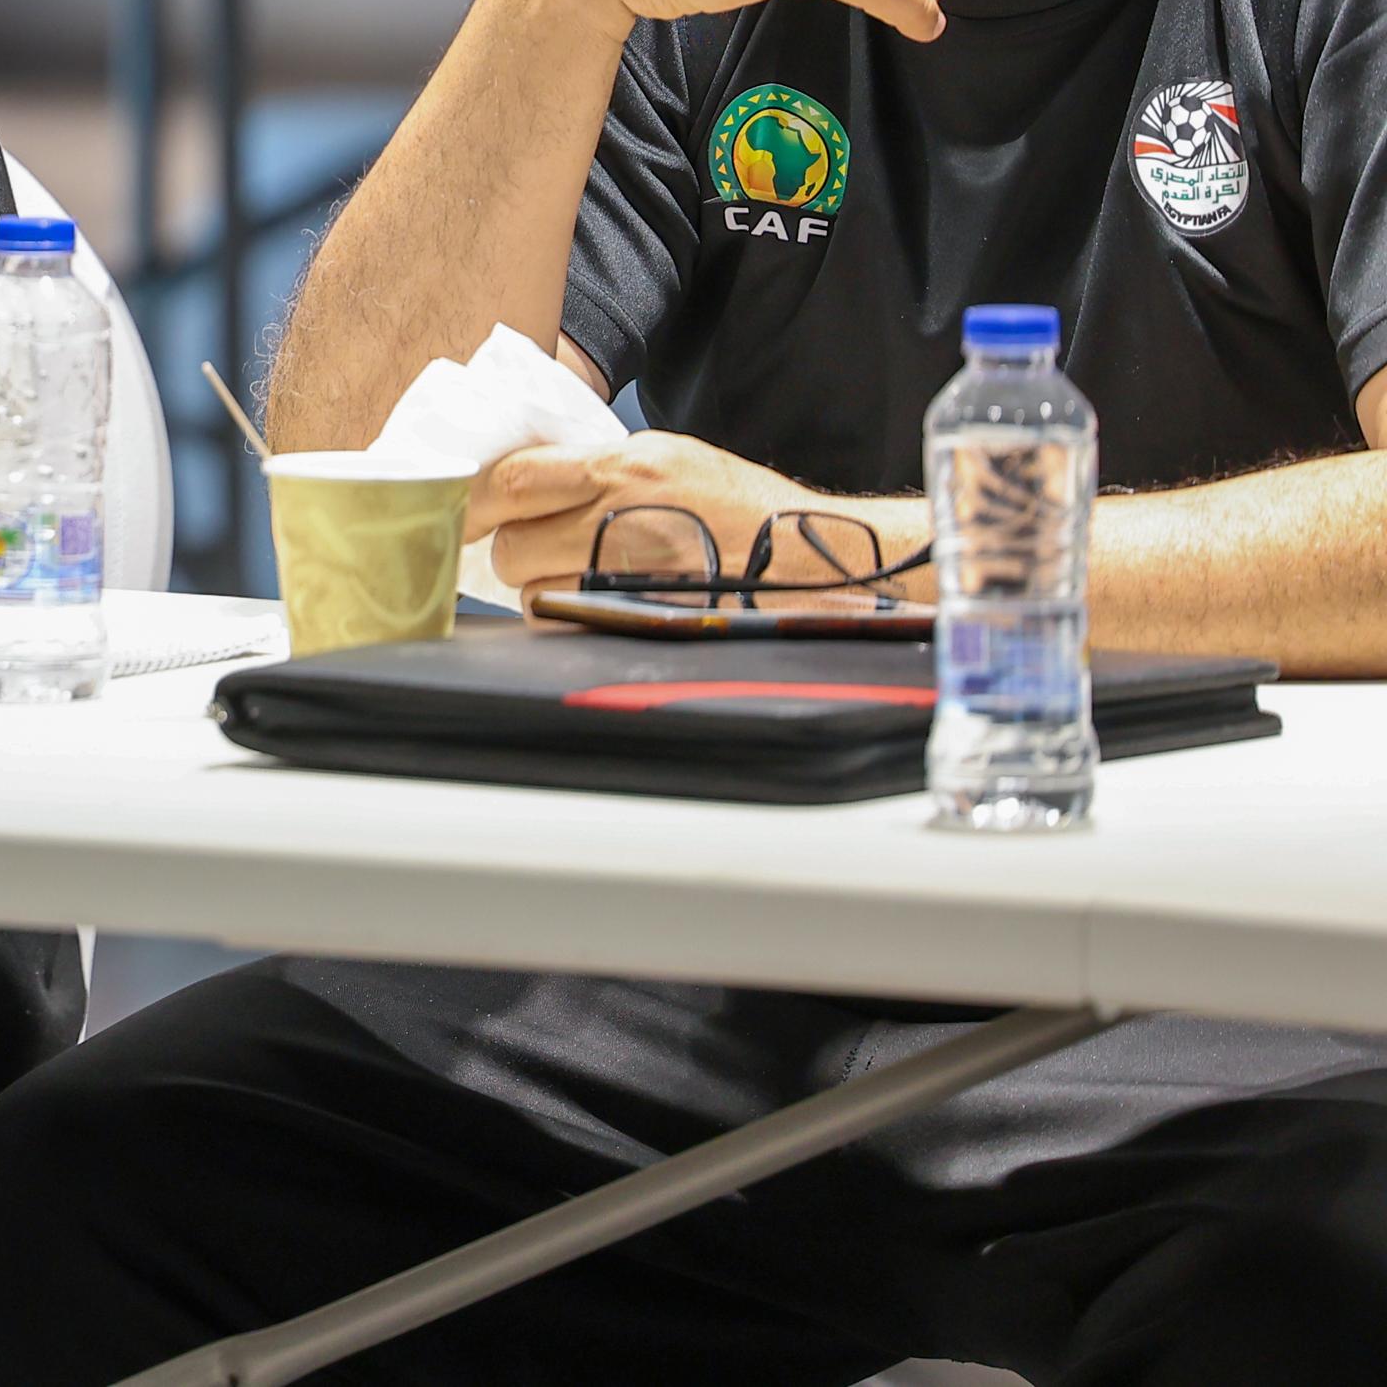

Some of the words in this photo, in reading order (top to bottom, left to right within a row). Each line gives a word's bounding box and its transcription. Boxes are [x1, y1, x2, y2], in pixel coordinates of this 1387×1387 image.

[1150, 167, 1204, 187] المصري
[1161, 185, 1200, 203] القدم
[1204, 179, 1240, 205] لكرة
[724, 206, 829, 244] CAF
[1163, 201, 1218, 227] EGYPTIAN
[1215, 204, 1233, 220] FA
